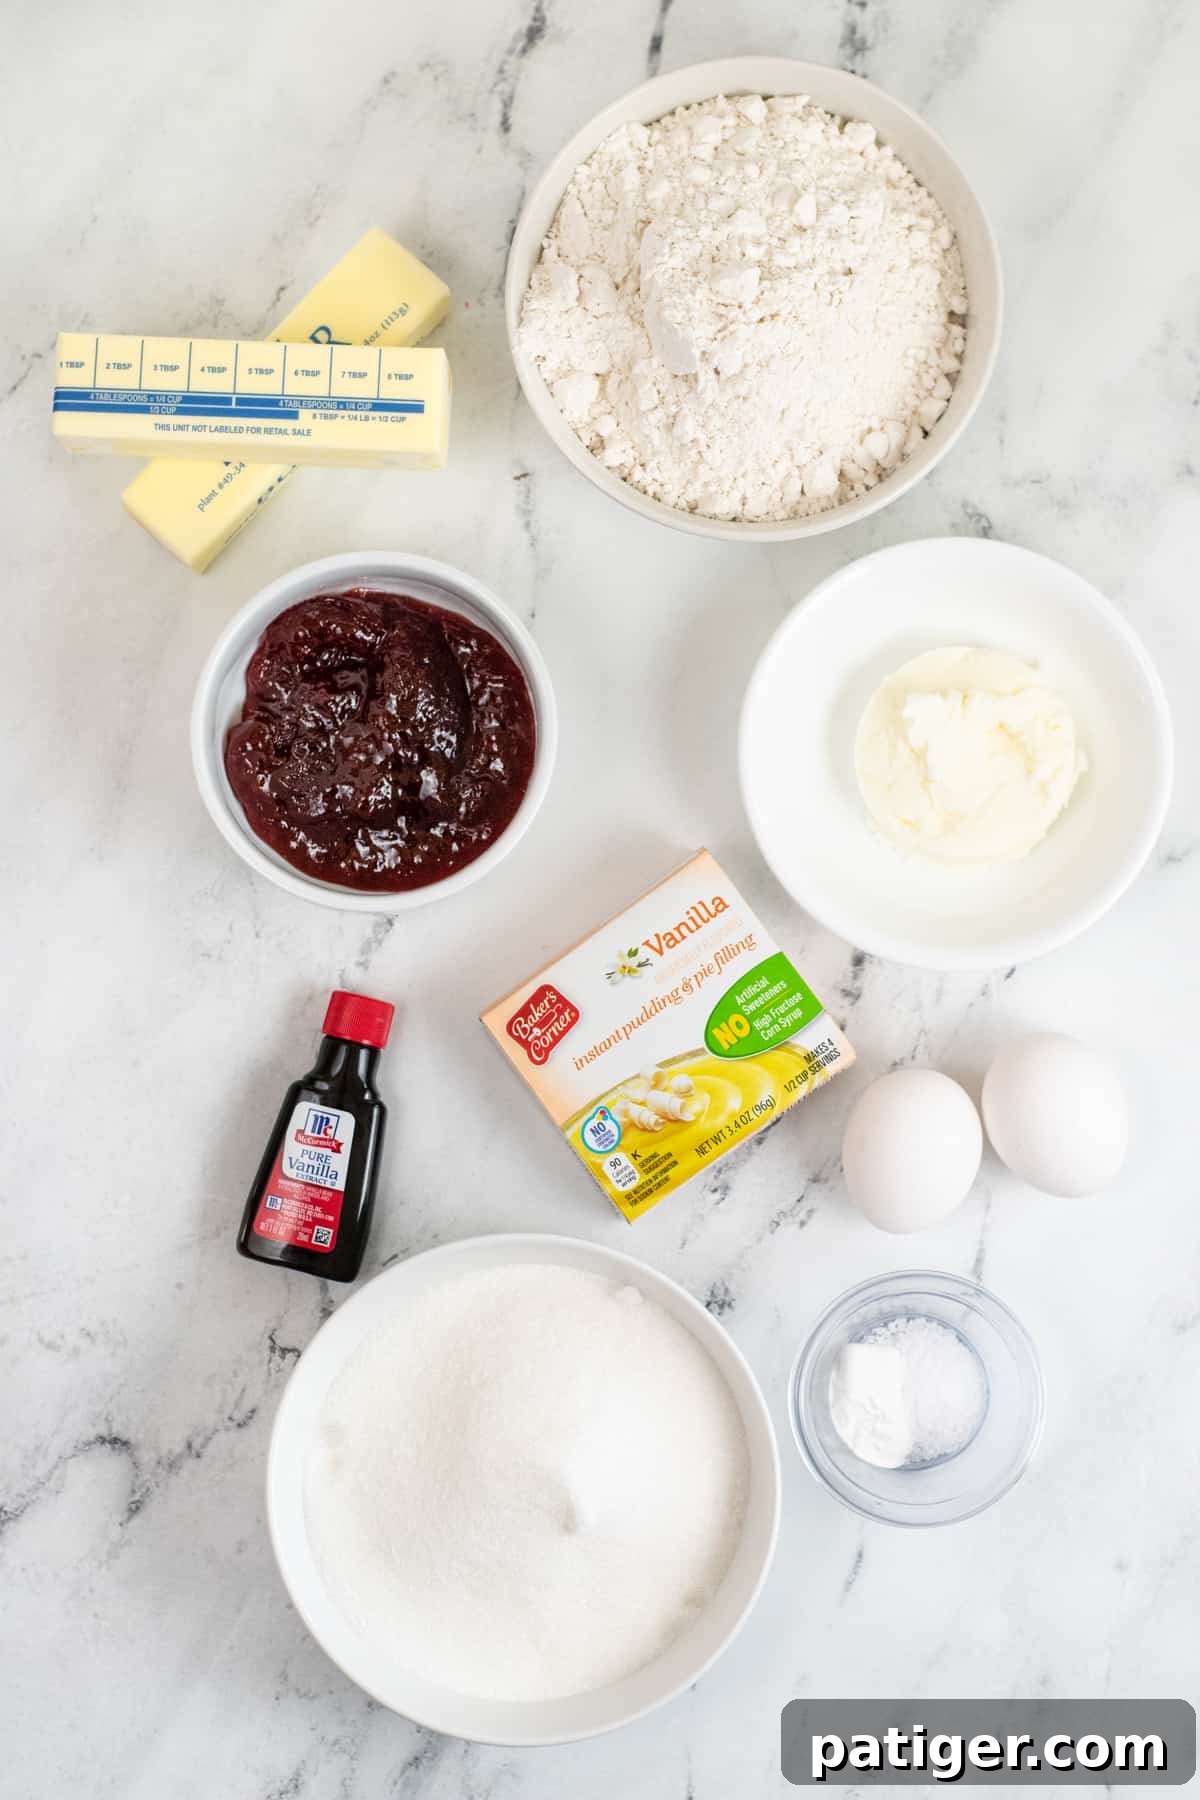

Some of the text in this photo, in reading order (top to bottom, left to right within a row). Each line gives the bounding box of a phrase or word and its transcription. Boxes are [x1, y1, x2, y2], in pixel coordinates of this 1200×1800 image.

[59, 361, 85, 369] 1 TBSP
[105, 362, 132, 370] 2 TBSP
[153, 364, 180, 372] 3 TBSP
[207, 366, 228, 374] TBSP
[254, 368, 274, 376] TBSP
[394, 373, 414, 381] TBSP
[94, 393, 148, 403] TABLESPOONS
[167, 396, 183, 404] CUP
[278, 400, 284, 408] 4
[284, 400, 338, 410] TABLESPOONS
[357, 402, 373, 411] CUP
[160, 406, 176, 415] CUP
[319, 413, 339, 421] TBSP
[359, 414, 370, 422] LB
[378, 414, 388, 422] 1/2
[390, 415, 406, 423] CUP
[154, 423, 312, 437] THIS UNIT NOT LABELED FOR RETAIL SALE
[198, 489, 218, 512] plant
[642, 896, 730, 957] Vanilla
[736, 976, 770, 1006] Artificial
[742, 980, 788, 1016] Sweeteners
[572, 1030, 624, 1071] instant
[622, 987, 683, 1041] pudding
[681, 977, 694, 994] &
[694, 964, 714, 988] pie
[714, 933, 757, 975] filling
[512, 991, 556, 1039] Baker's
[752, 992, 804, 1030] High Fructose
[712, 1013, 750, 1050] NO
[760, 1007, 804, 1042] Corn Syrup
[531, 1008, 571, 1061] Corner
[804, 1038, 834, 1064] MAKES 4
[784, 1048, 840, 1094] 1/2 CUP SERVINGS
[590, 1122, 606, 1138] NO
[694, 1095, 777, 1158] NET WT 3.4 OZ (96g)
[298, 1134, 336, 1148] McCormick
[300, 1148, 332, 1164] PURE
[631, 1149, 641, 1160] K
[288, 1156, 338, 1180] Vanilla
[610, 1157, 622, 1170] 90
[296, 1172, 328, 1184] EXTRACT
